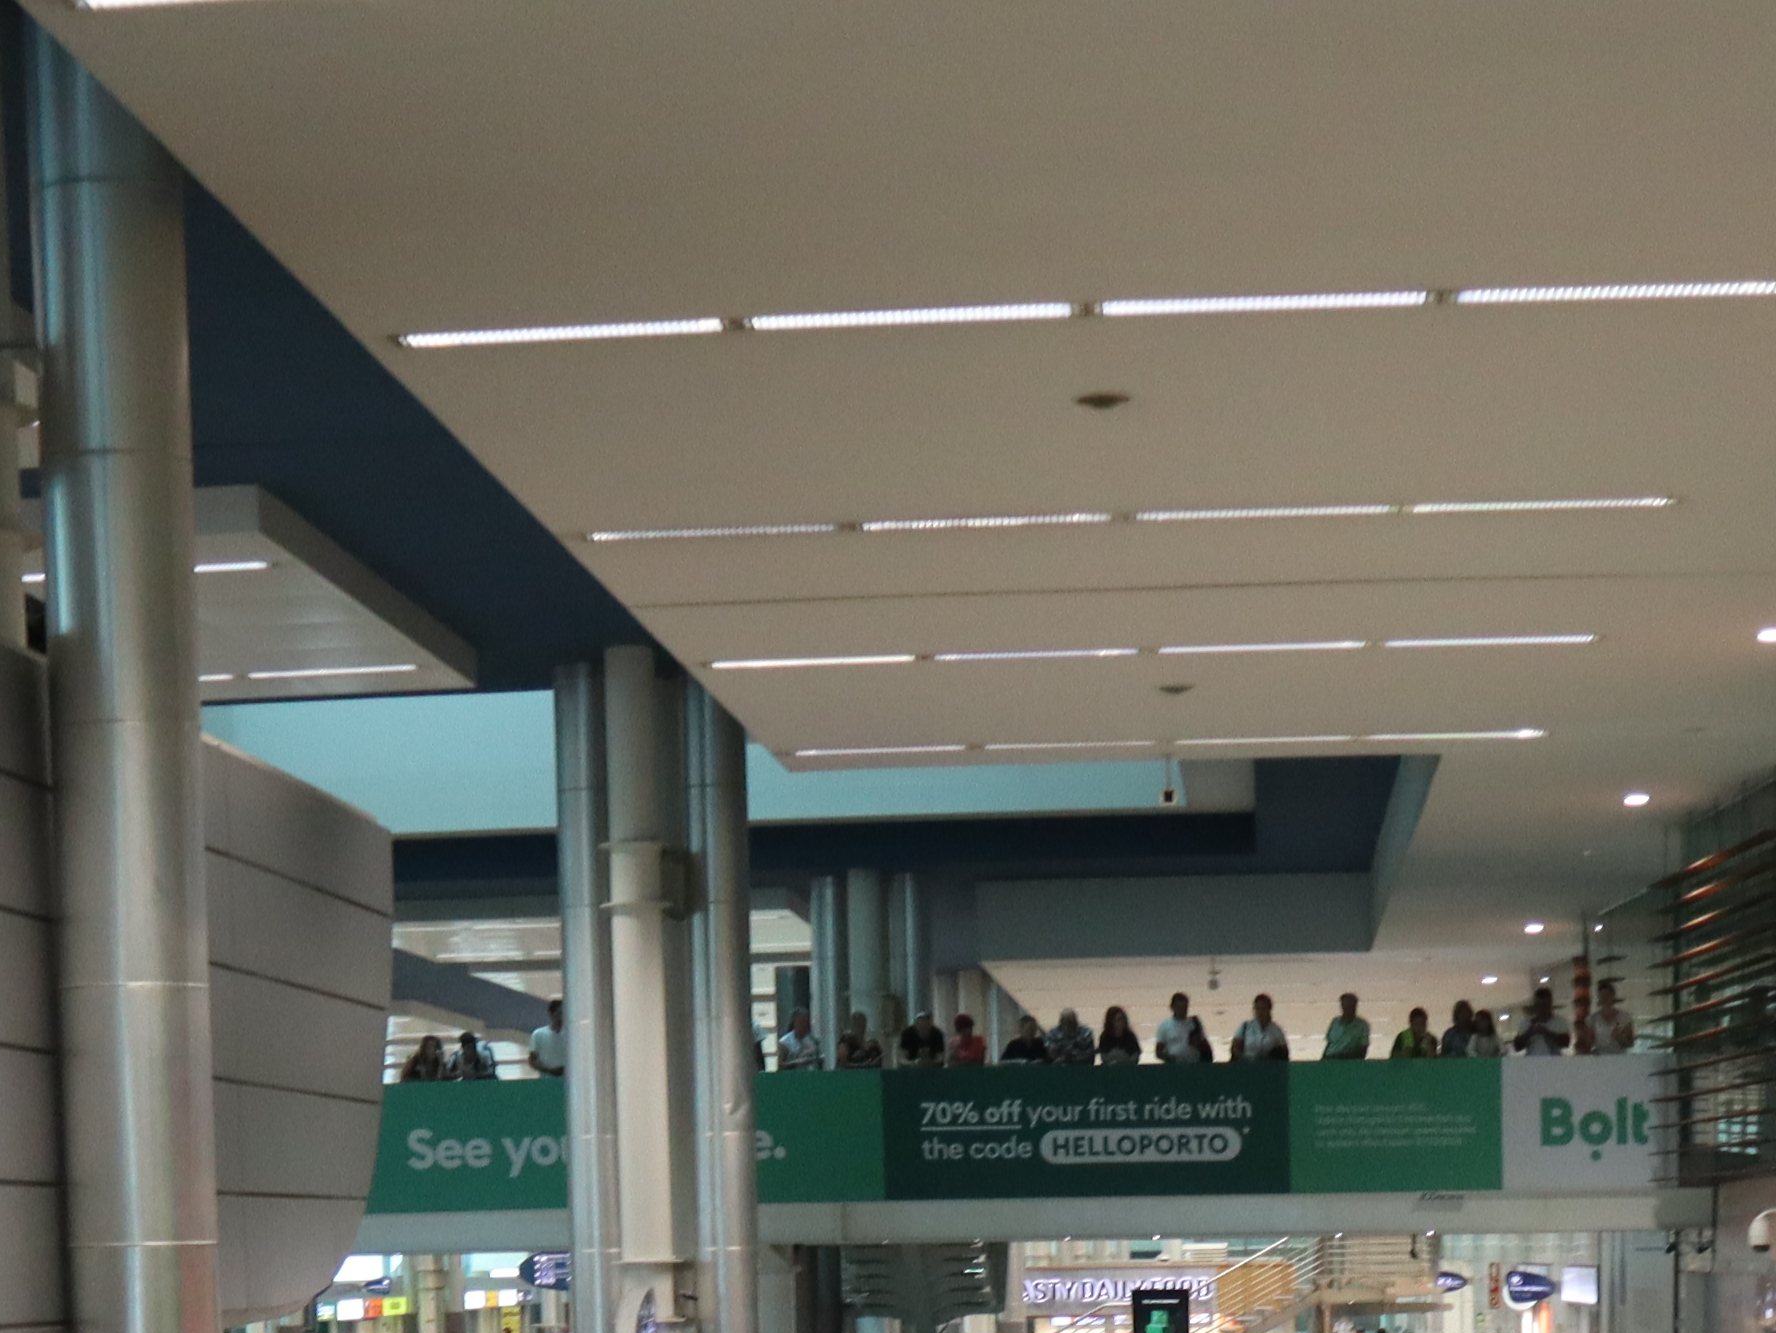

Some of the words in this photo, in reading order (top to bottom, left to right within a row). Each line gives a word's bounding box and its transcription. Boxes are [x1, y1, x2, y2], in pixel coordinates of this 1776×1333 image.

[921, 1102, 979, 1124] 70%
[985, 1100, 1022, 1123] off
[1027, 1105, 1083, 1128] your
[1087, 1098, 1137, 1121] first
[1144, 1096, 1191, 1120] ride
[1198, 1094, 1252, 1119] with
[1540, 1096, 1649, 1161] Bolt
[407, 1128, 492, 1169] See
[922, 1138, 967, 1160] the
[970, 1136, 1032, 1159] code
[1051, 1134, 1230, 1157] HELLOPORTO
[1023, 1278, 1079, 1302] ASTY
